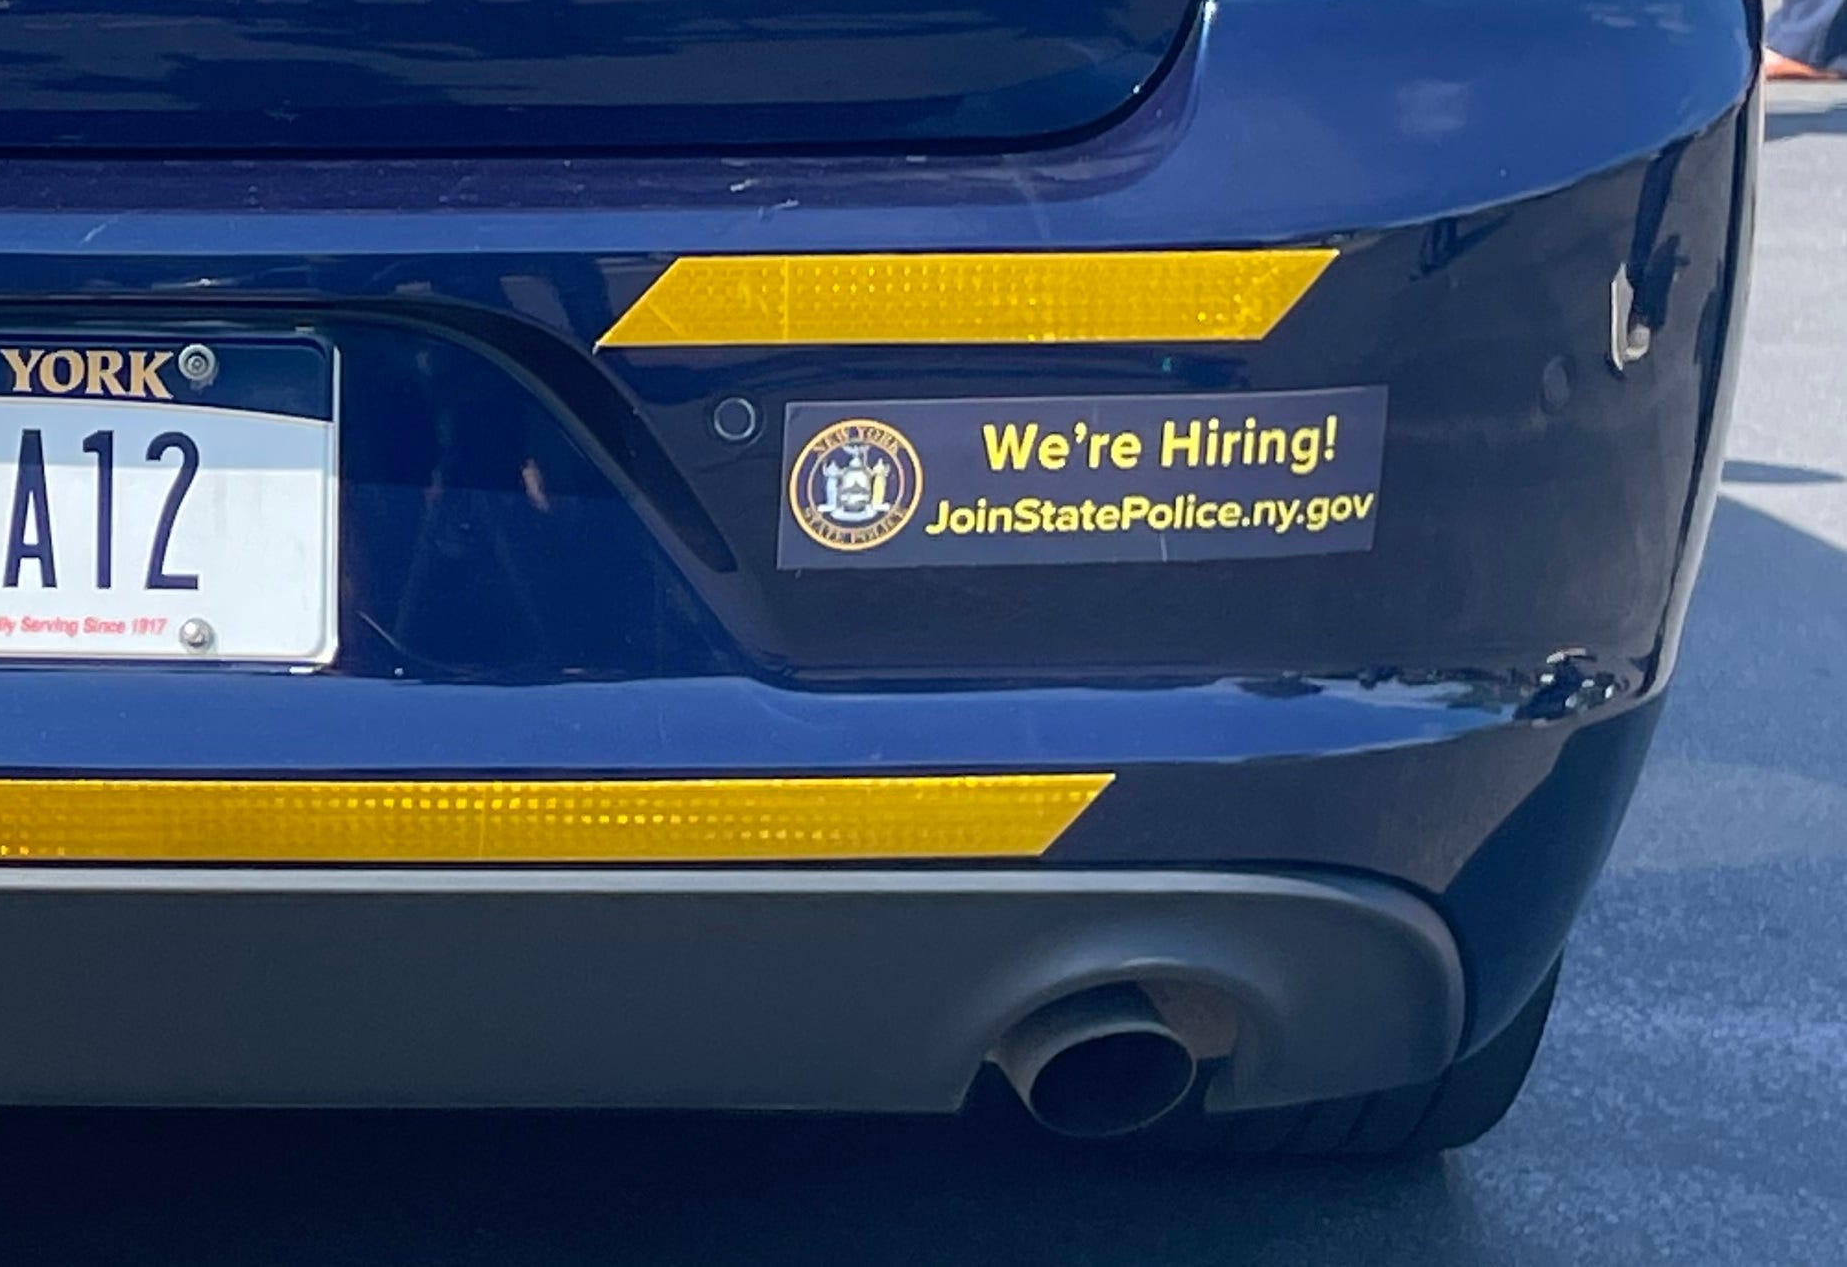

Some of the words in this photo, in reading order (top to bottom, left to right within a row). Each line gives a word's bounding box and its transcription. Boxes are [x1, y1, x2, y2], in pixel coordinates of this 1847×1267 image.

[0, 348, 175, 400] YORK
[982, 422, 1142, 471] We're
[1159, 415, 1338, 474] Hiring!
[2, 428, 200, 591] A12
[924, 492, 1375, 535] JoinStatePolice.ny.gov
[20, 616, 78, 638] Serving
[83, 616, 126, 634] Since
[131, 617, 168, 634] 1917
